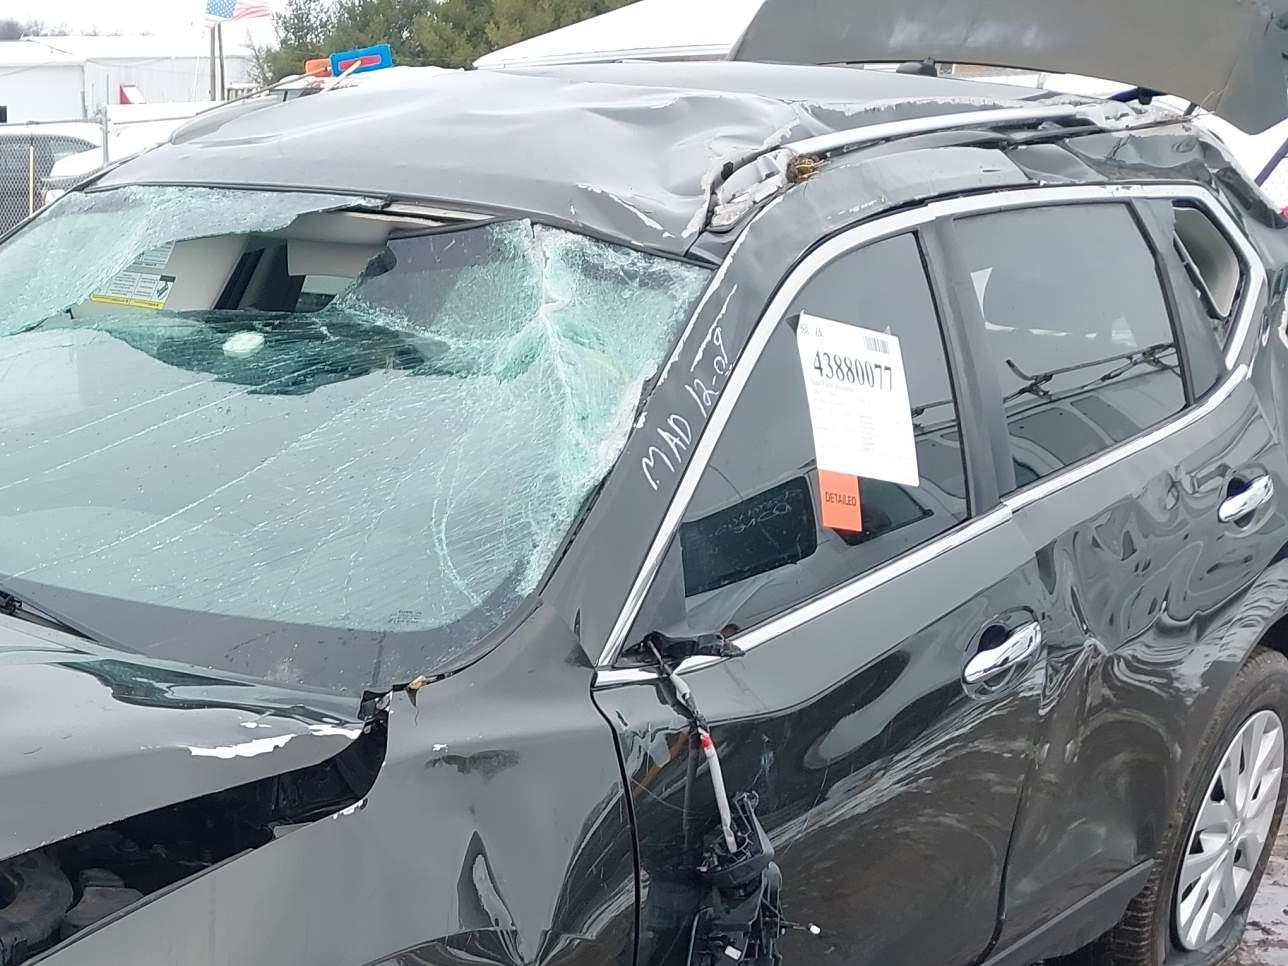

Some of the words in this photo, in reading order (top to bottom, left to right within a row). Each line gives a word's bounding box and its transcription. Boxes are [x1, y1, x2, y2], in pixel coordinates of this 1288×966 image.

[813, 350, 893, 393] 43880077
[641, 414, 693, 490] MAD
[824, 491, 857, 507] DETAILED
